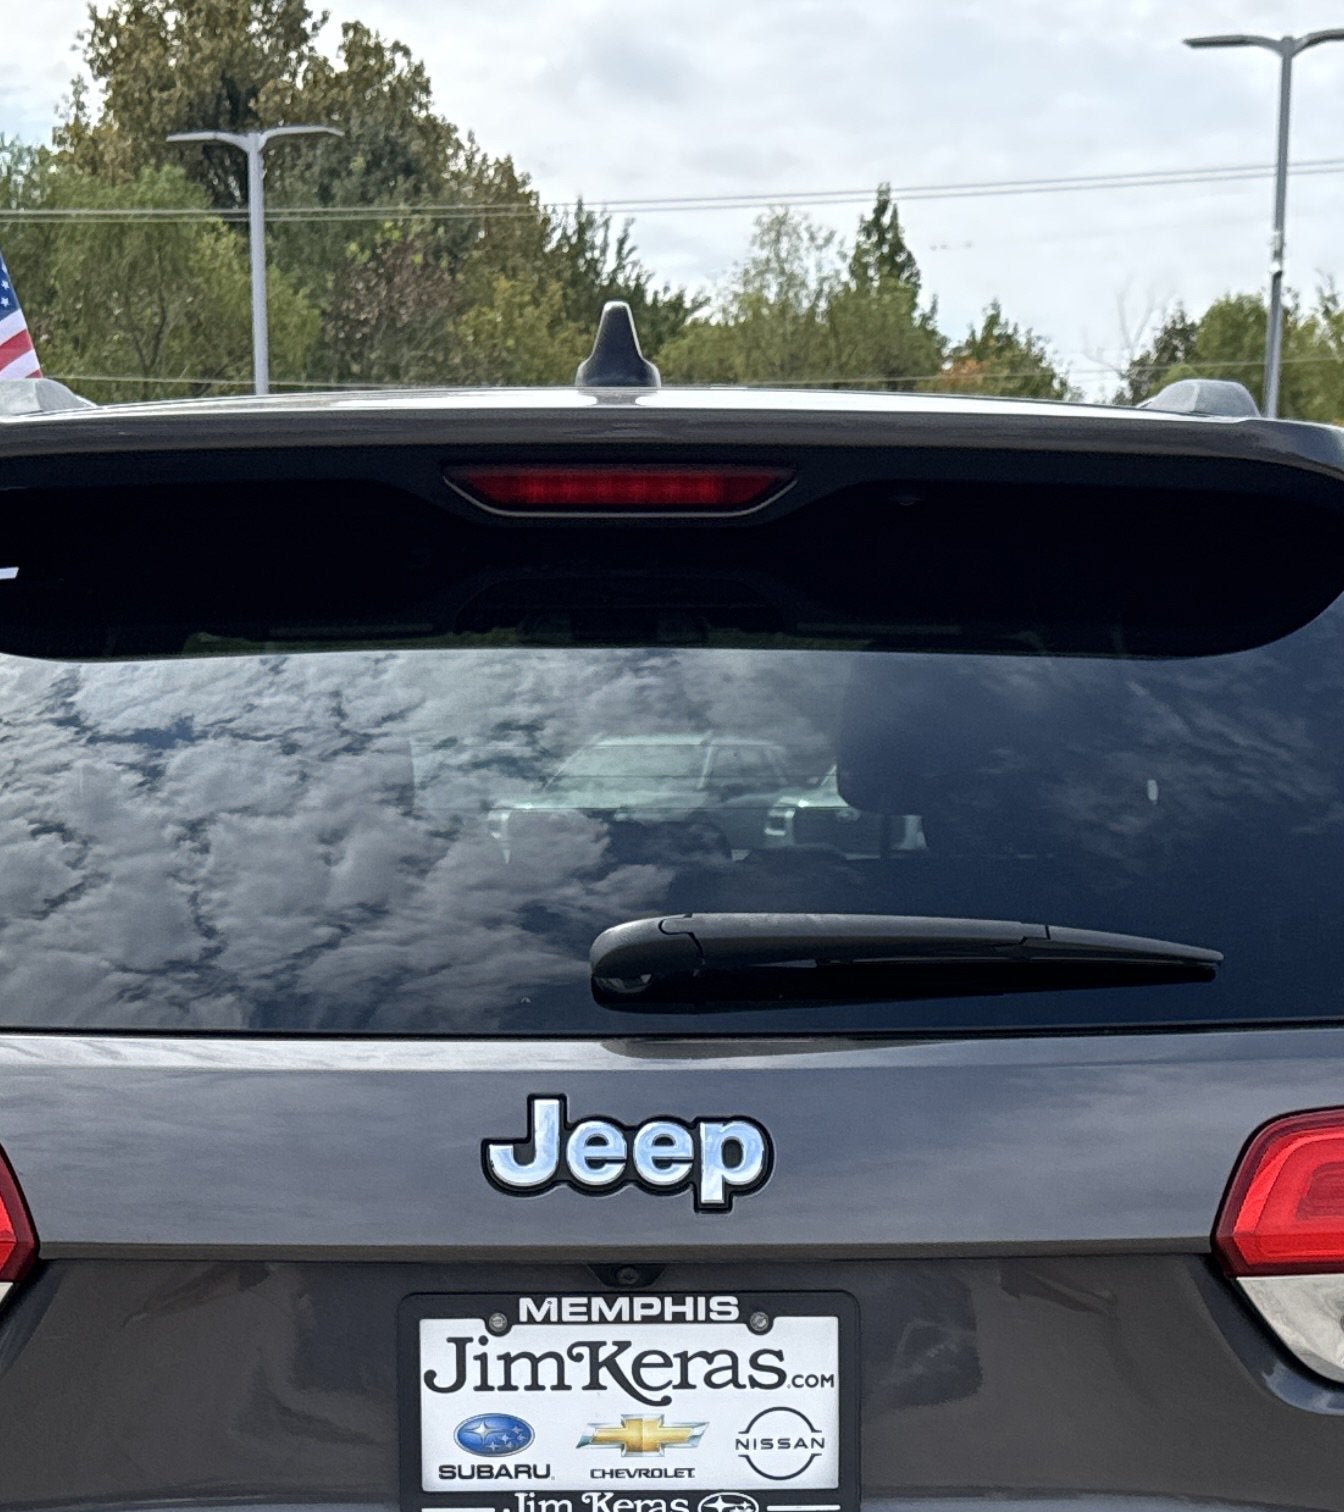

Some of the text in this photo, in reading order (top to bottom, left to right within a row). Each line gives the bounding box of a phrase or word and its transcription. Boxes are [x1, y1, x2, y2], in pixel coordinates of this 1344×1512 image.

[485, 1096, 770, 1208] Jeep
[519, 1296, 740, 1323] MEMPHIS
[735, 1436, 826, 1451] NISSAN
[438, 1464, 552, 1480] SUBARU
[590, 1468, 696, 1479] CHEVROLET
